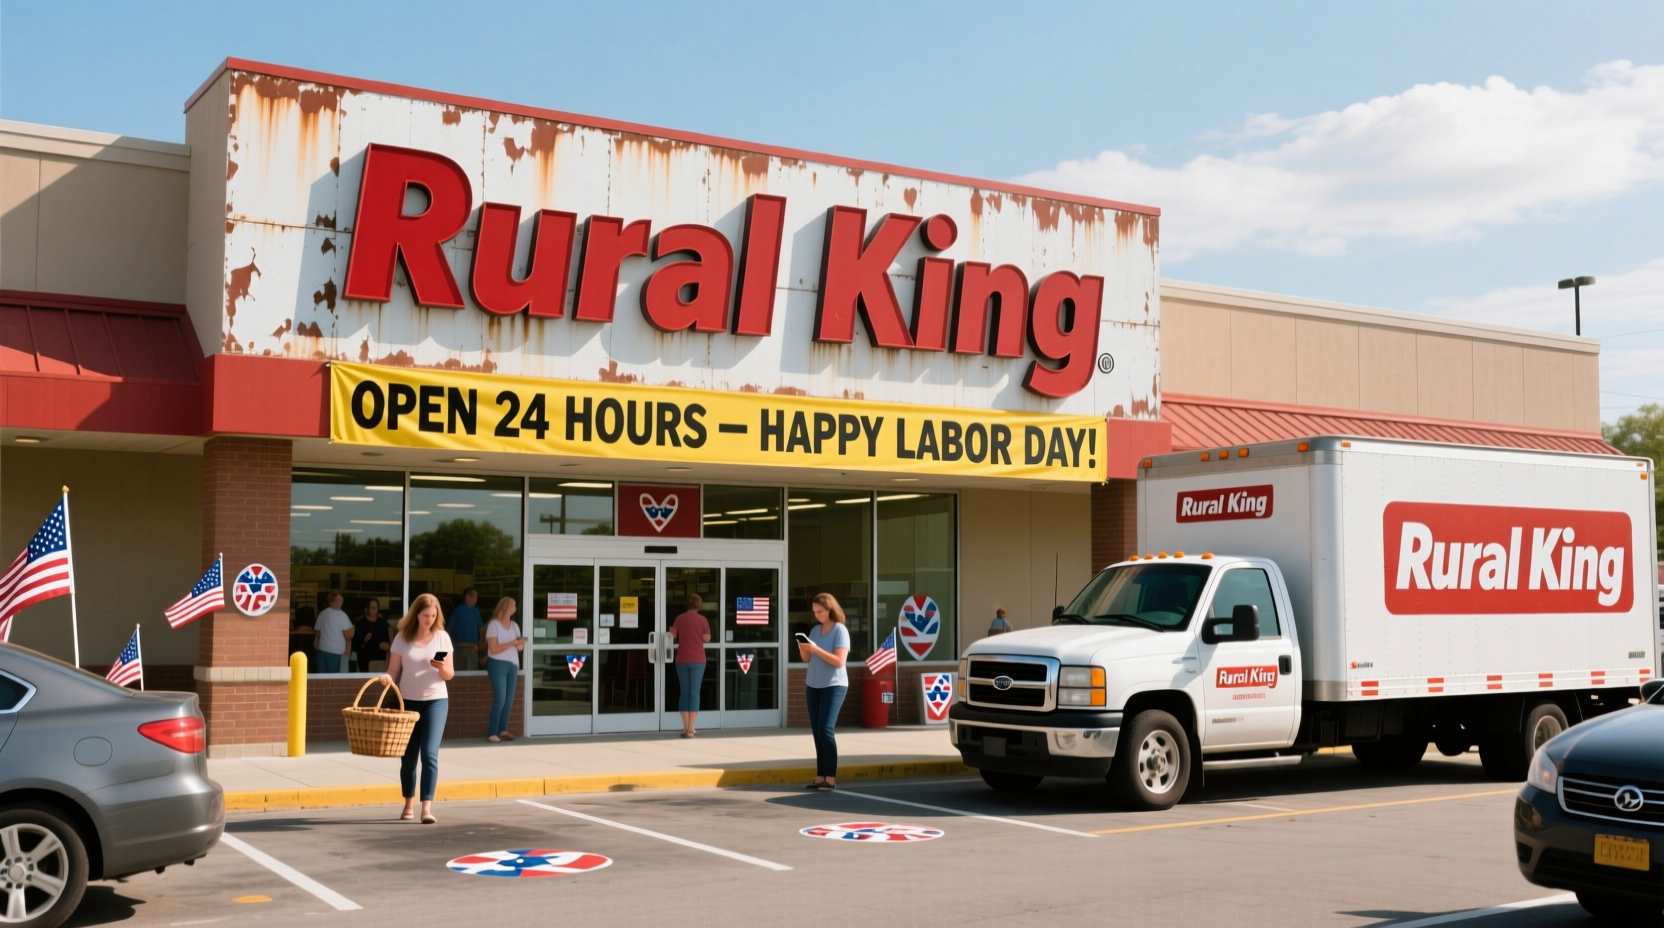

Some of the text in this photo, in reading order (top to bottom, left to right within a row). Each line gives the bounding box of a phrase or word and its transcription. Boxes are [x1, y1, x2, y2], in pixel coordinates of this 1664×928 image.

[342, 142, 1105, 399] Rural King
[351, 380, 478, 436] OPEN
[494, 390, 550, 440] 24
[565, 395, 708, 450] HOURS
[760, 408, 884, 457] HAPPY
[896, 417, 1012, 466] LABOR
[1024, 425, 1097, 469] DAY!
[1181, 491, 1268, 517] Rural King
[1395, 521, 1625, 607] Rural King
[1219, 667, 1276, 686] Rural King
